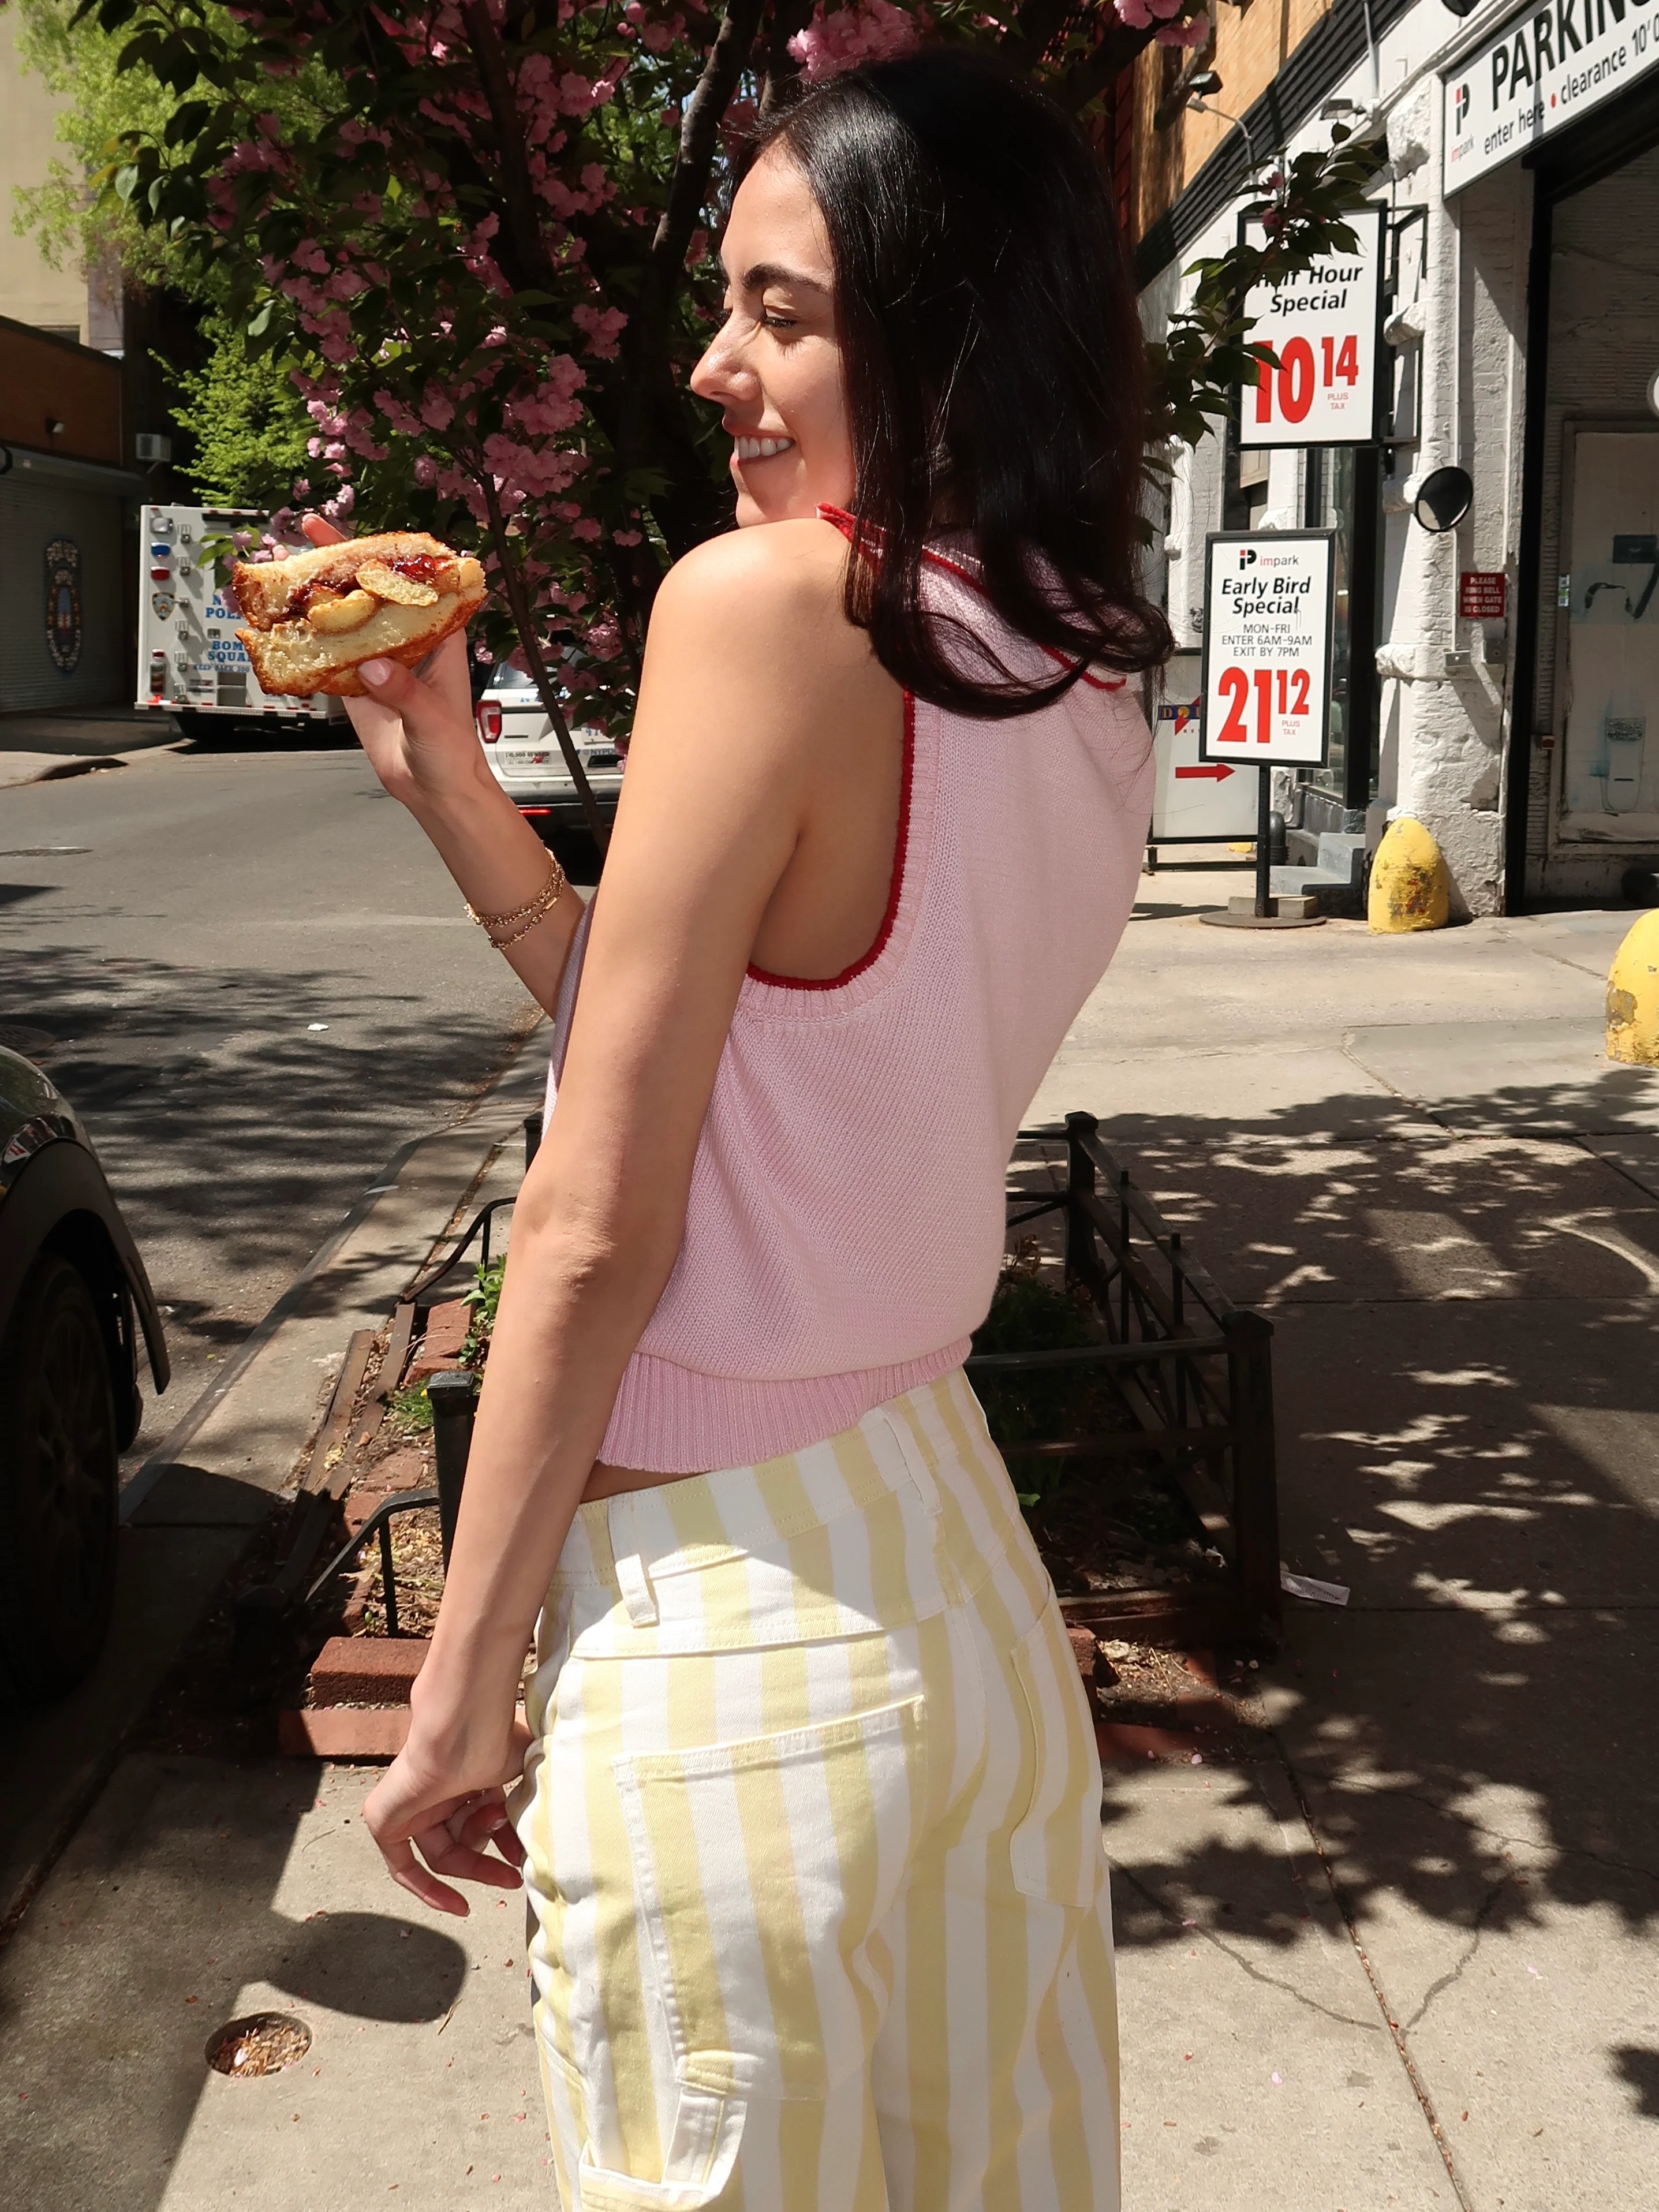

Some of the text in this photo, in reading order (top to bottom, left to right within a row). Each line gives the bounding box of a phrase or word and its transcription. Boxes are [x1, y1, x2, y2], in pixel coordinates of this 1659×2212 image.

[1492, 0, 1650, 111] PARKI
[1484, 122, 1514, 155] enter
[1518, 102, 1545, 134] here
[1561, 46, 1627, 105] clearance
[1451, 133, 1475, 163] impark
[1309, 265, 1363, 284] Hour
[1270, 288, 1347, 317] Special
[1253, 335, 1359, 424] 10 14
[1260, 555, 1299, 569] impark
[1221, 576, 1311, 599] Early Bird
[1232, 596, 1300, 618] Special
[1243, 624, 1291, 634] MON-FRI
[212, 640, 244, 651] BOM
[1222, 636, 1312, 645] ENTER 6AM-9AM
[208, 651, 252, 663] SQUA
[1233, 647, 1299, 657] EXIT BY 7PM
[1216, 666, 1310, 743] 21 12
